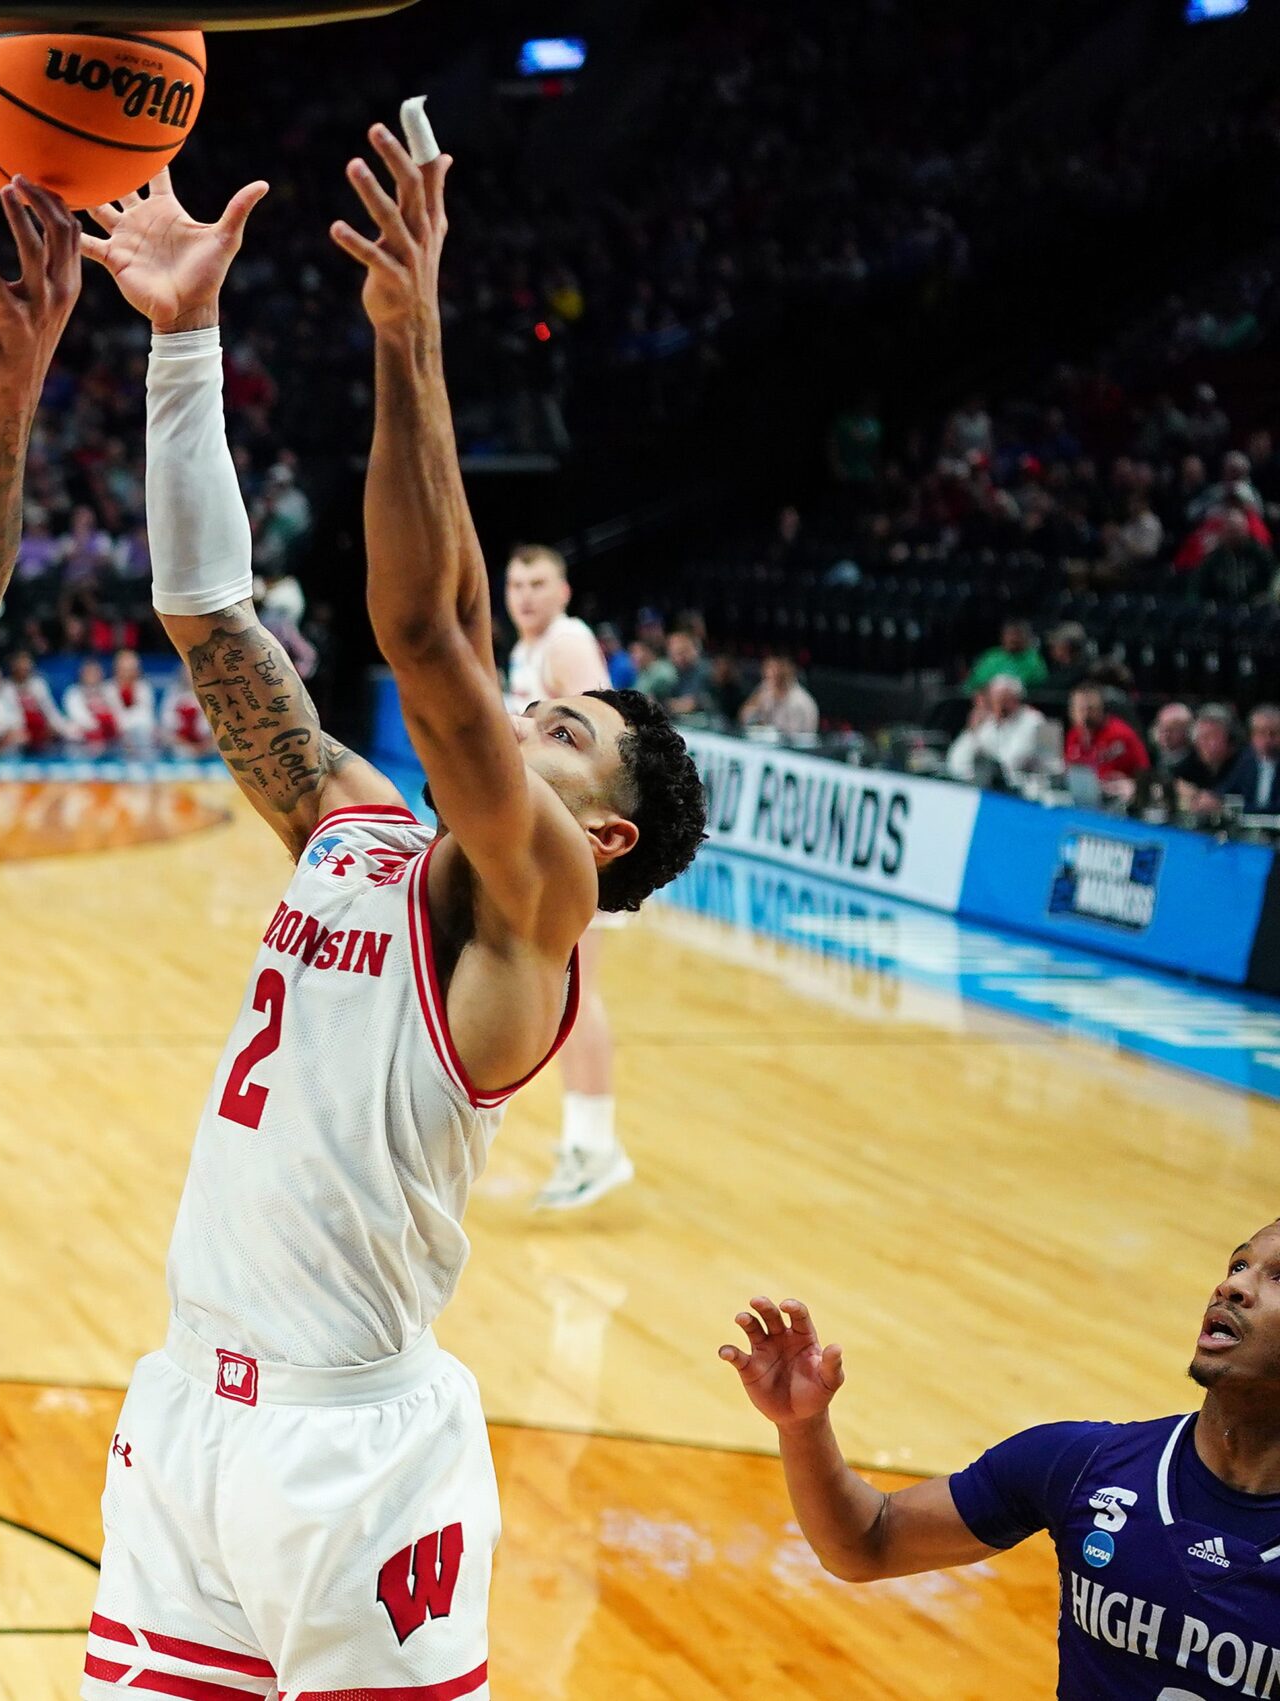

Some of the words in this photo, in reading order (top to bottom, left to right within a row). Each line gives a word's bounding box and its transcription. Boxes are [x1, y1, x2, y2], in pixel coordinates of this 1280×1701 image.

[46, 47, 195, 128] Wilson
[267, 695, 291, 712] by
[269, 727, 320, 786] God
[753, 763, 910, 876] ROUNDS
[218, 968, 286, 1130] 2
[376, 1521, 464, 1646] W
[1085, 1544, 1111, 1562] NCAA
[1187, 1545, 1231, 1568] adidas
[1071, 1570, 1167, 1661] HIGH
